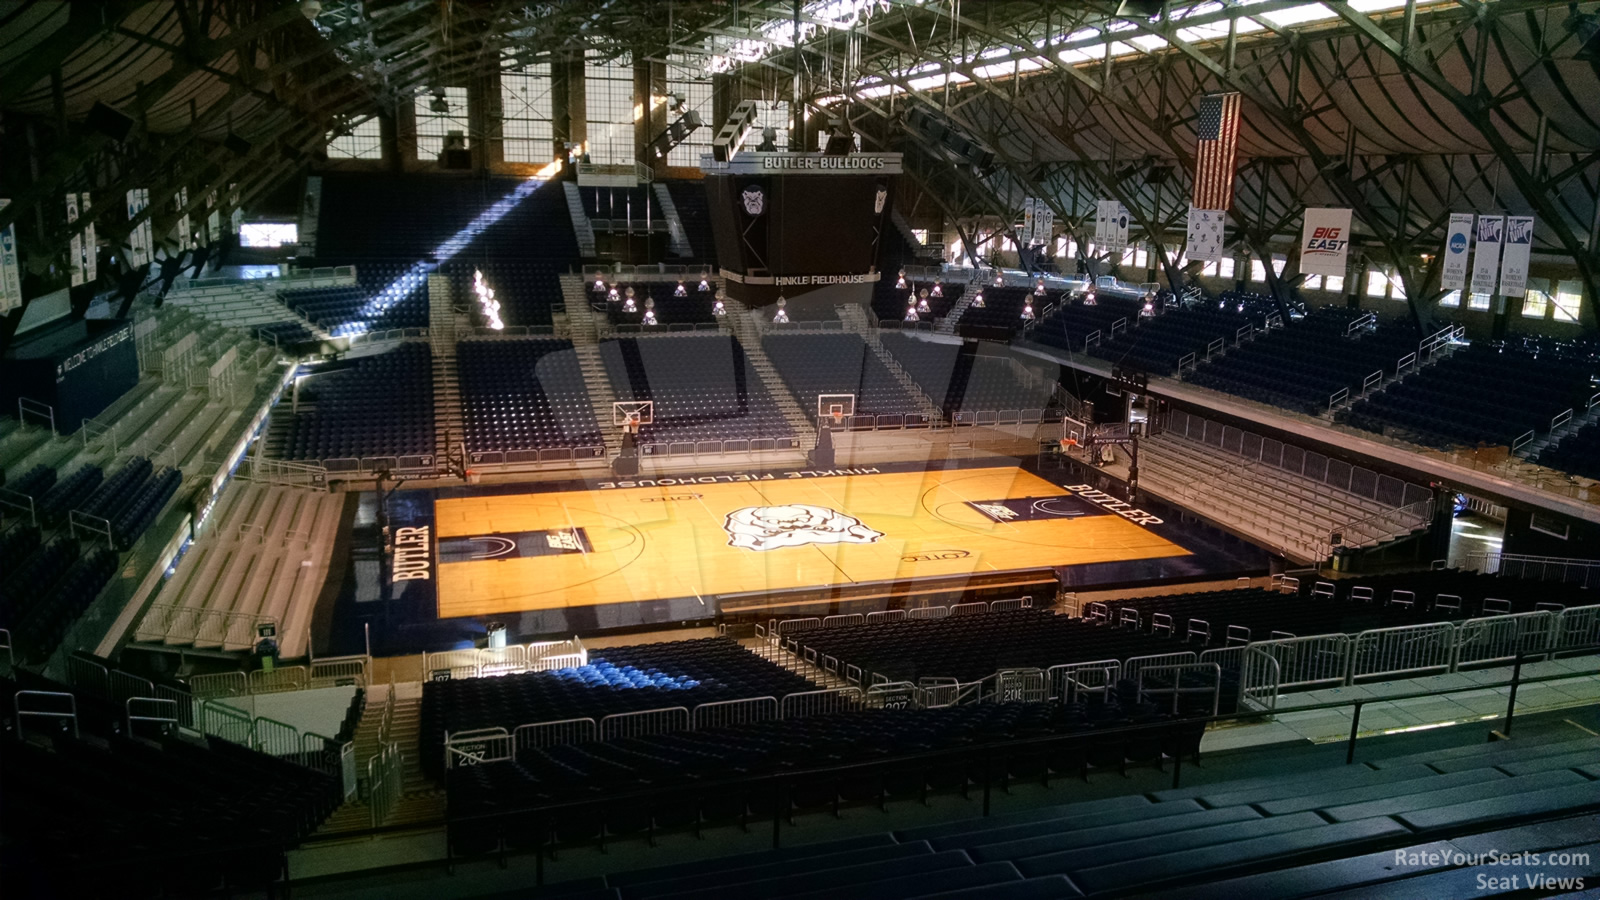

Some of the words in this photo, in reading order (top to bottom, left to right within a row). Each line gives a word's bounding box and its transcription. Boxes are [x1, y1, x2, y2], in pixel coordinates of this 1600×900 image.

[764, 157, 814, 169] BUTLER
[820, 157, 884, 169] BULLDOGS
[1312, 227, 1342, 239] BIG
[1307, 239, 1348, 251] EAST
[775, 276, 808, 286] HINKLE
[811, 275, 864, 285] FIELDHOUSE
[784, 467, 880, 479] HINKLE
[598, 473, 775, 489] FIELDHOUSE
[1063, 484, 1165, 525] BUTLER
[393, 525, 430, 582] BUTLER
[885, 694, 910, 702] SECTION
[459, 744, 486, 752] SECTION
[458, 751, 487, 767] 207
